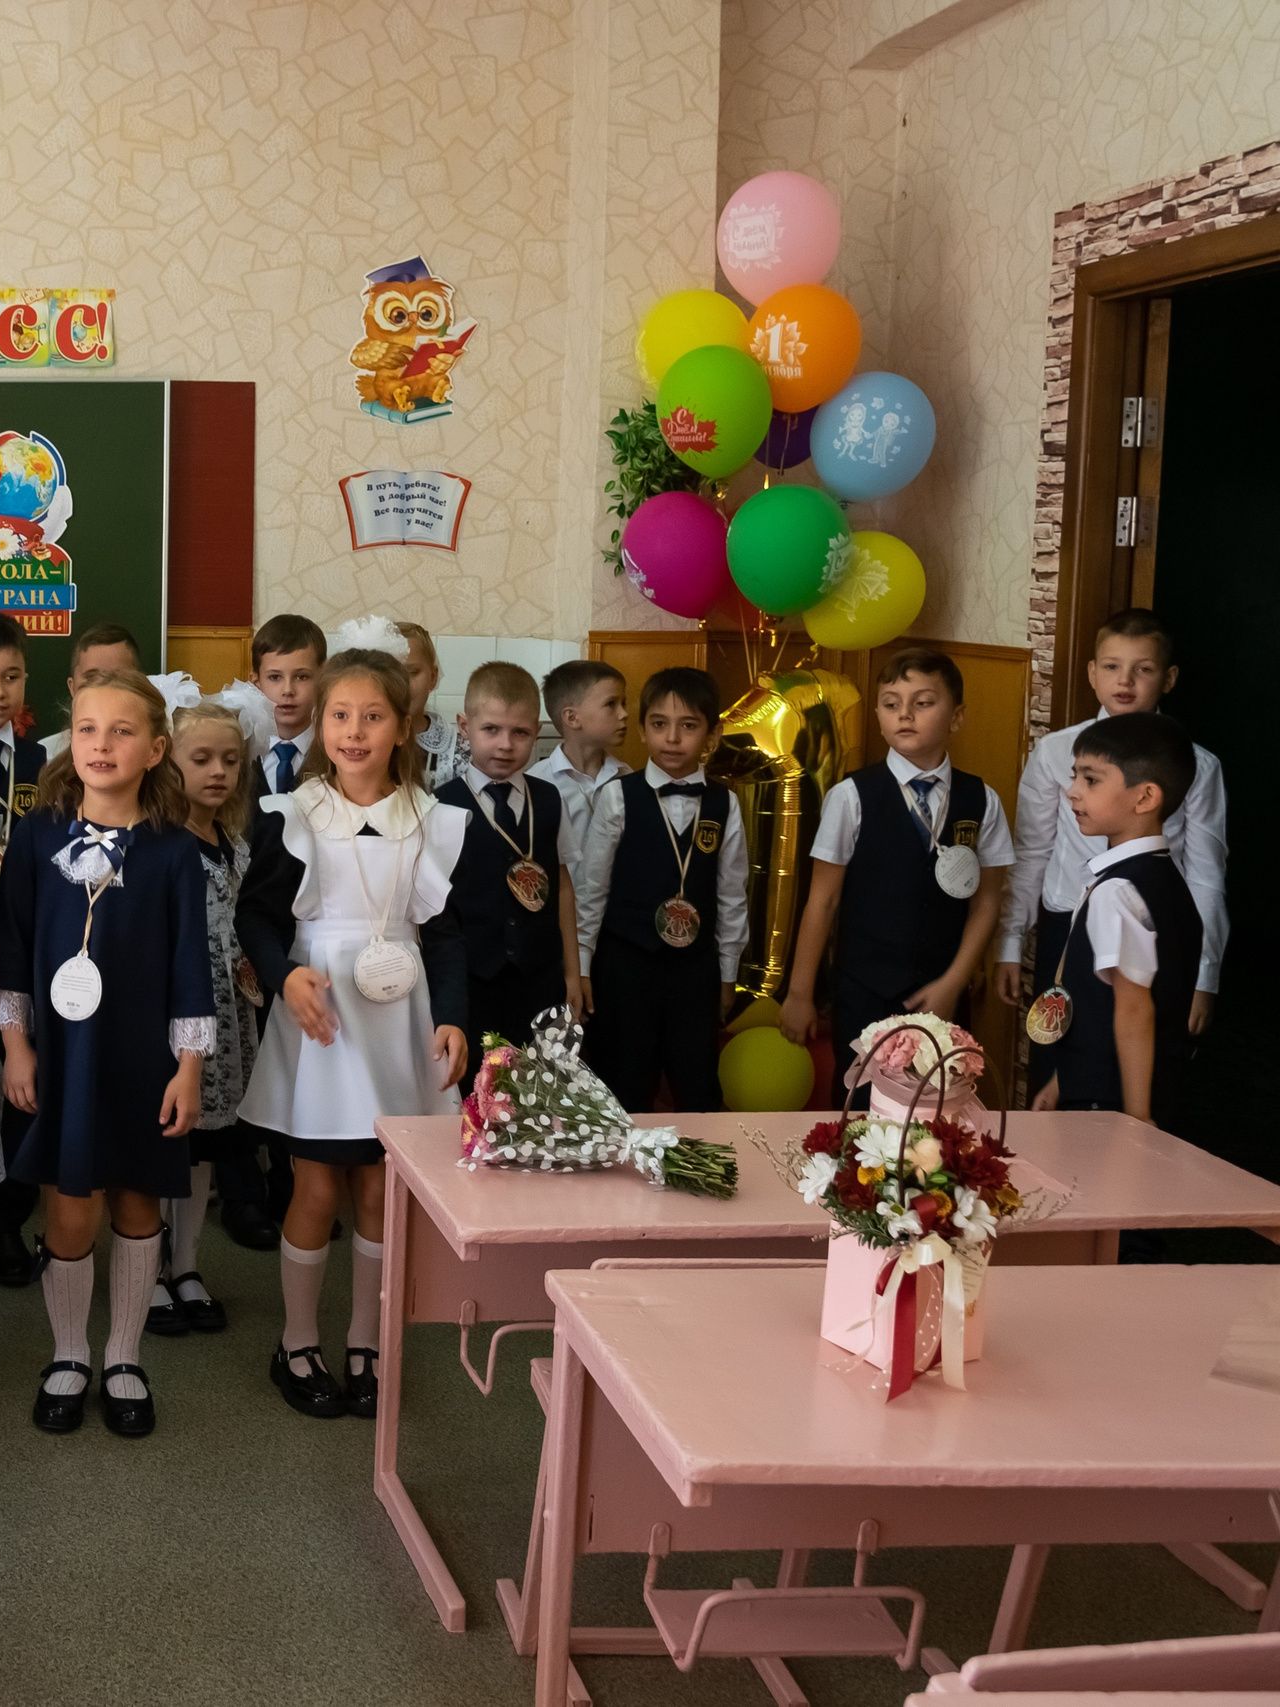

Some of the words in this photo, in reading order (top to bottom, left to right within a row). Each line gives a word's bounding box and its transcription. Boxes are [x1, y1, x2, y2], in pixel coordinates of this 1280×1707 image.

[376, 482, 401, 491] путь,
[405, 481, 440, 493] ребята!
[378, 495, 385, 503] В
[388, 492, 426, 502] добрый
[429, 496, 447, 507] час!
[374, 507, 390, 517] Все
[392, 507, 443, 520] получится
[415, 519, 434, 529] вас!
[20, 794, 31, 807] 16
[702, 830, 713, 843] 16
